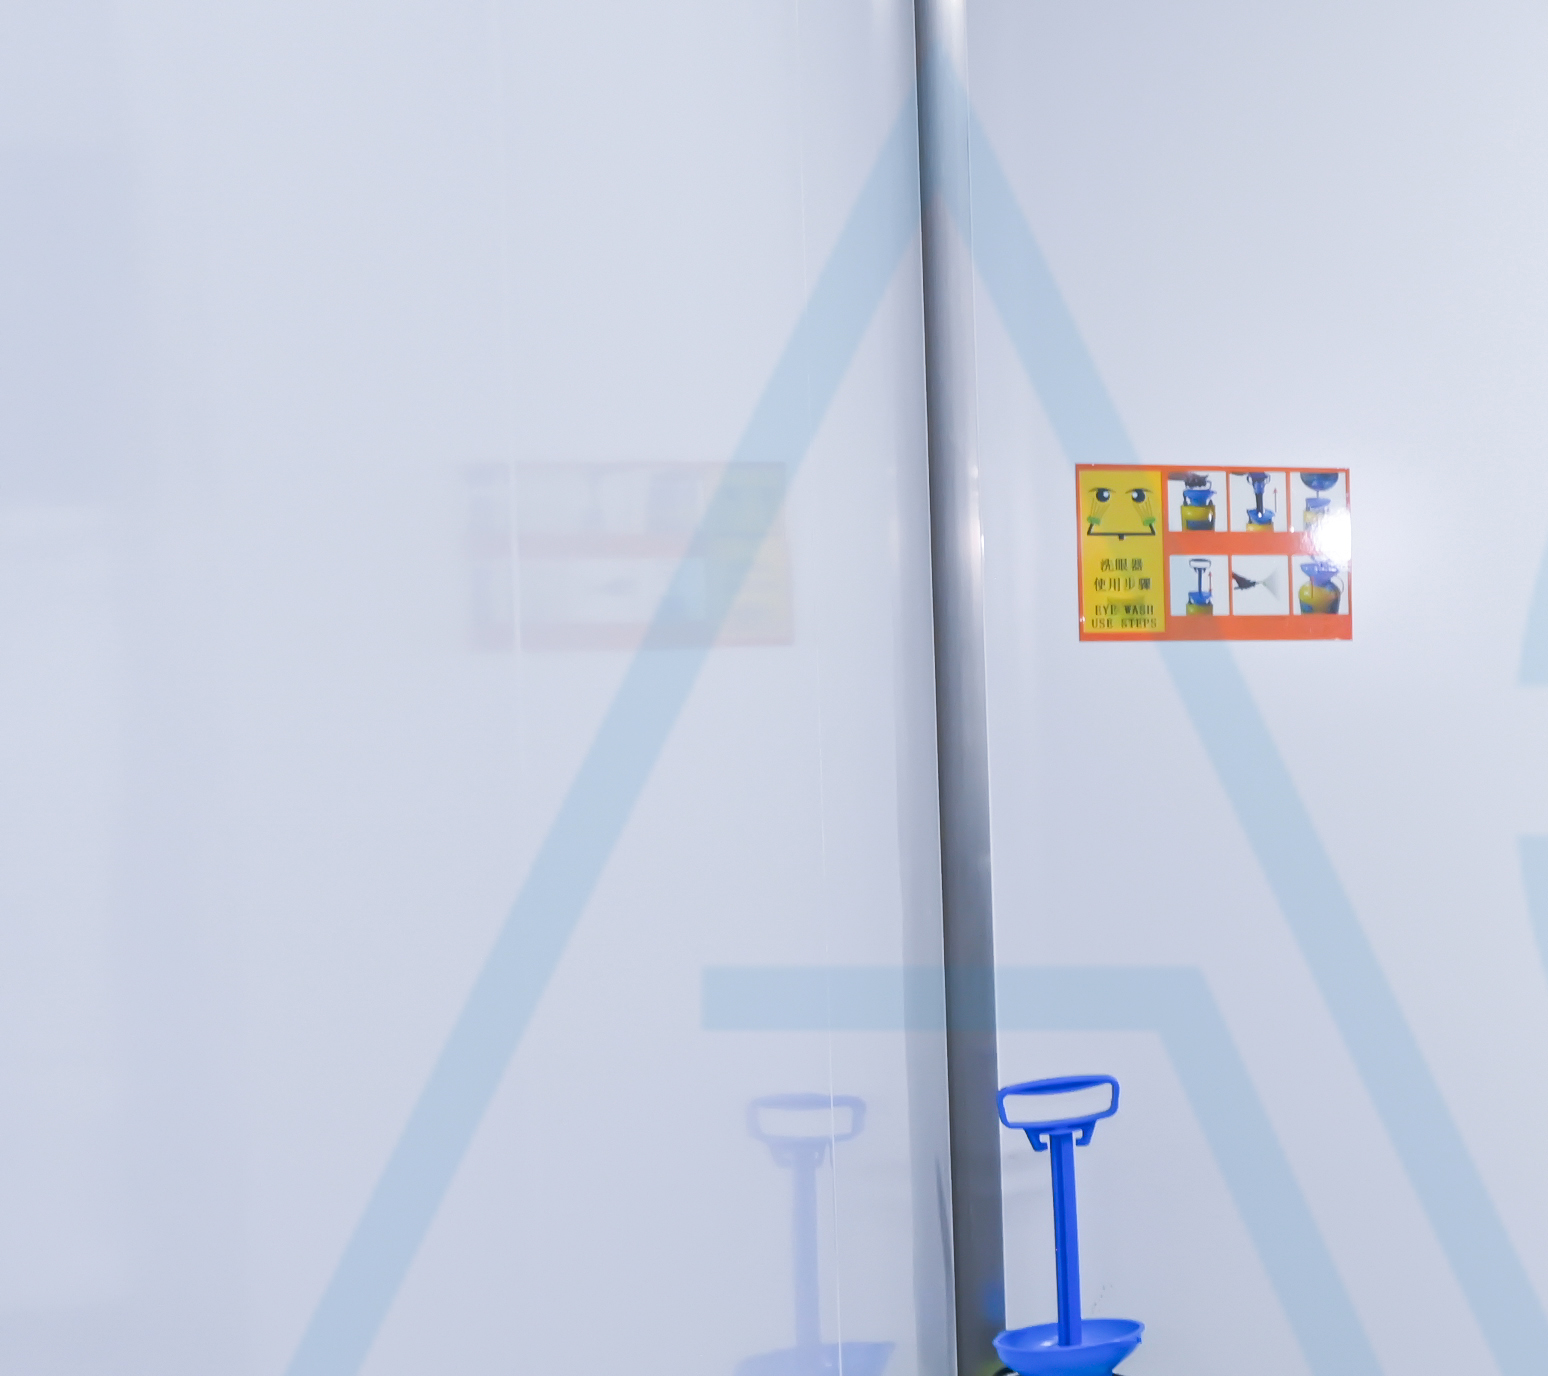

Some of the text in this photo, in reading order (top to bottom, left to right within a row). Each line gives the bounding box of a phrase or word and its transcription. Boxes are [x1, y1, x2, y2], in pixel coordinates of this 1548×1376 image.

[1100, 558, 1143, 572] 洗眼器
[1095, 605, 1154, 615] EYE WASH
[1091, 618, 1157, 629] USE STEPS
